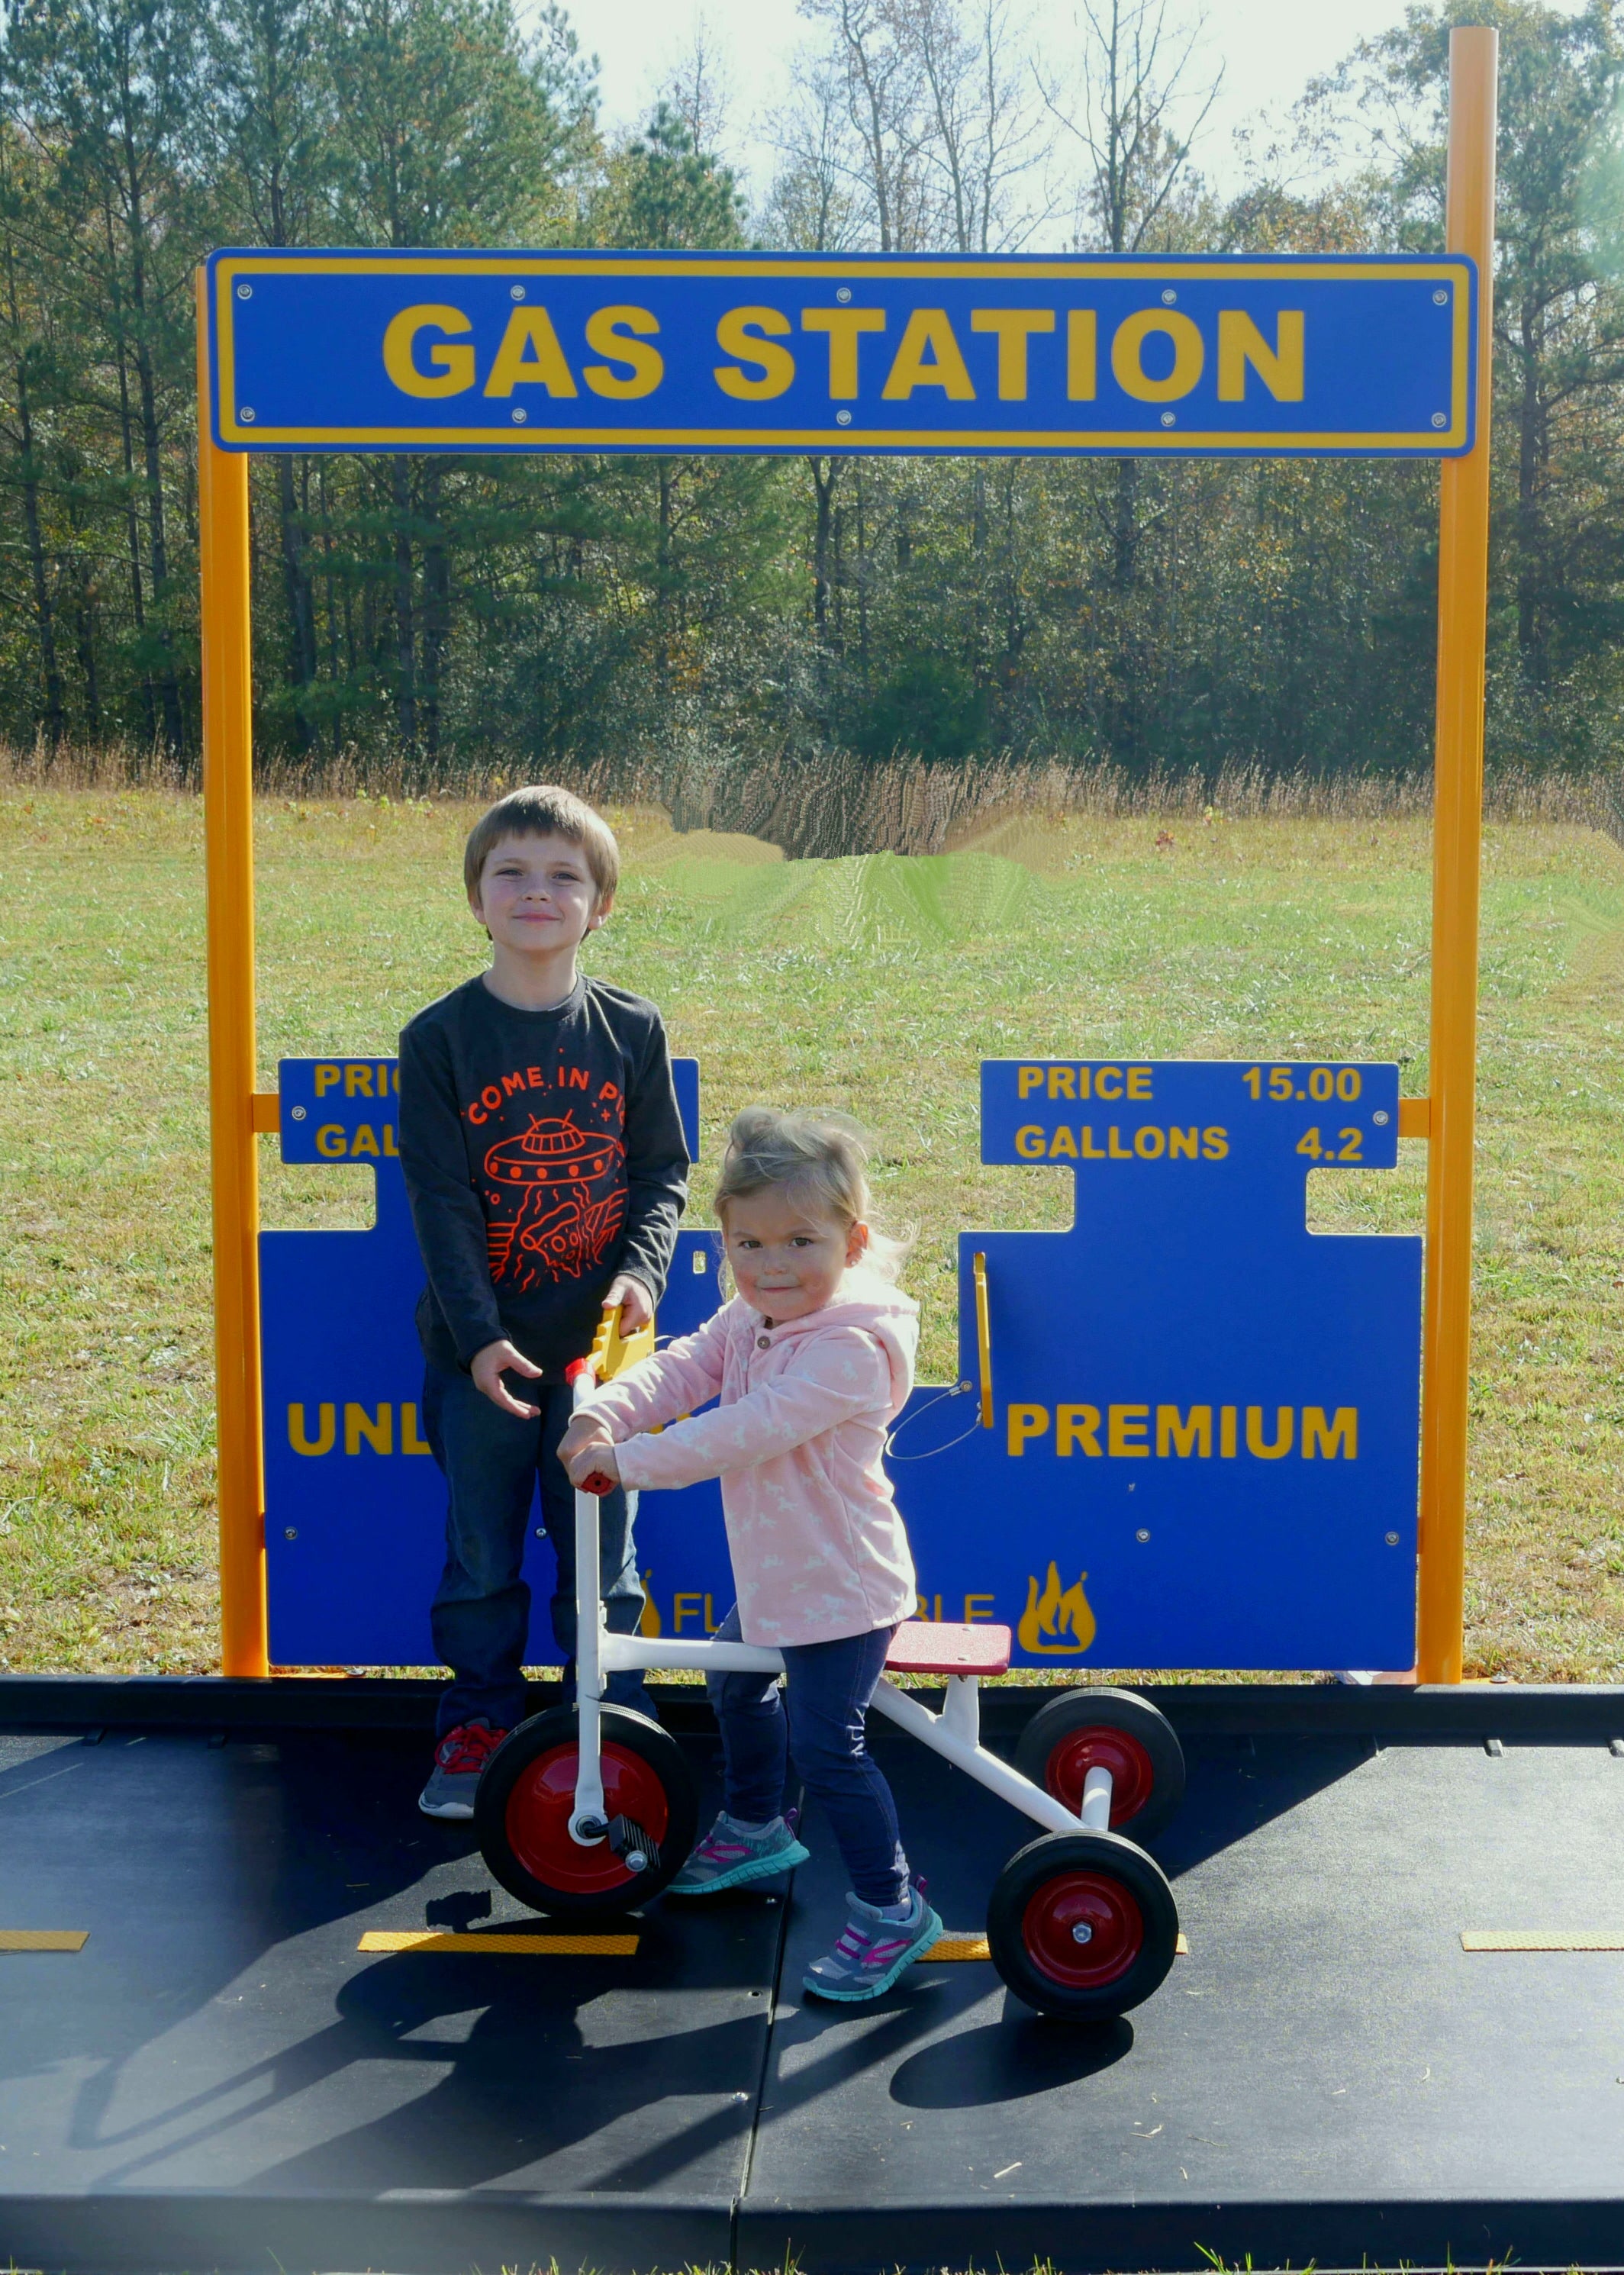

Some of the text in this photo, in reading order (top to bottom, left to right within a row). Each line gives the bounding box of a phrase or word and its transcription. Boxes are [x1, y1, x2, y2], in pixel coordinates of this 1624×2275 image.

[382, 304, 1305, 402] GAS STATION
[314, 1064, 400, 1097] PRI
[469, 1066, 544, 1125] COME
[559, 1066, 590, 1091] IN
[1017, 1066, 1362, 1101] PRICE 15.00
[1015, 1125, 1364, 1162] GALLONS 4.2
[1007, 1403, 1358, 1460] PREMIUM
